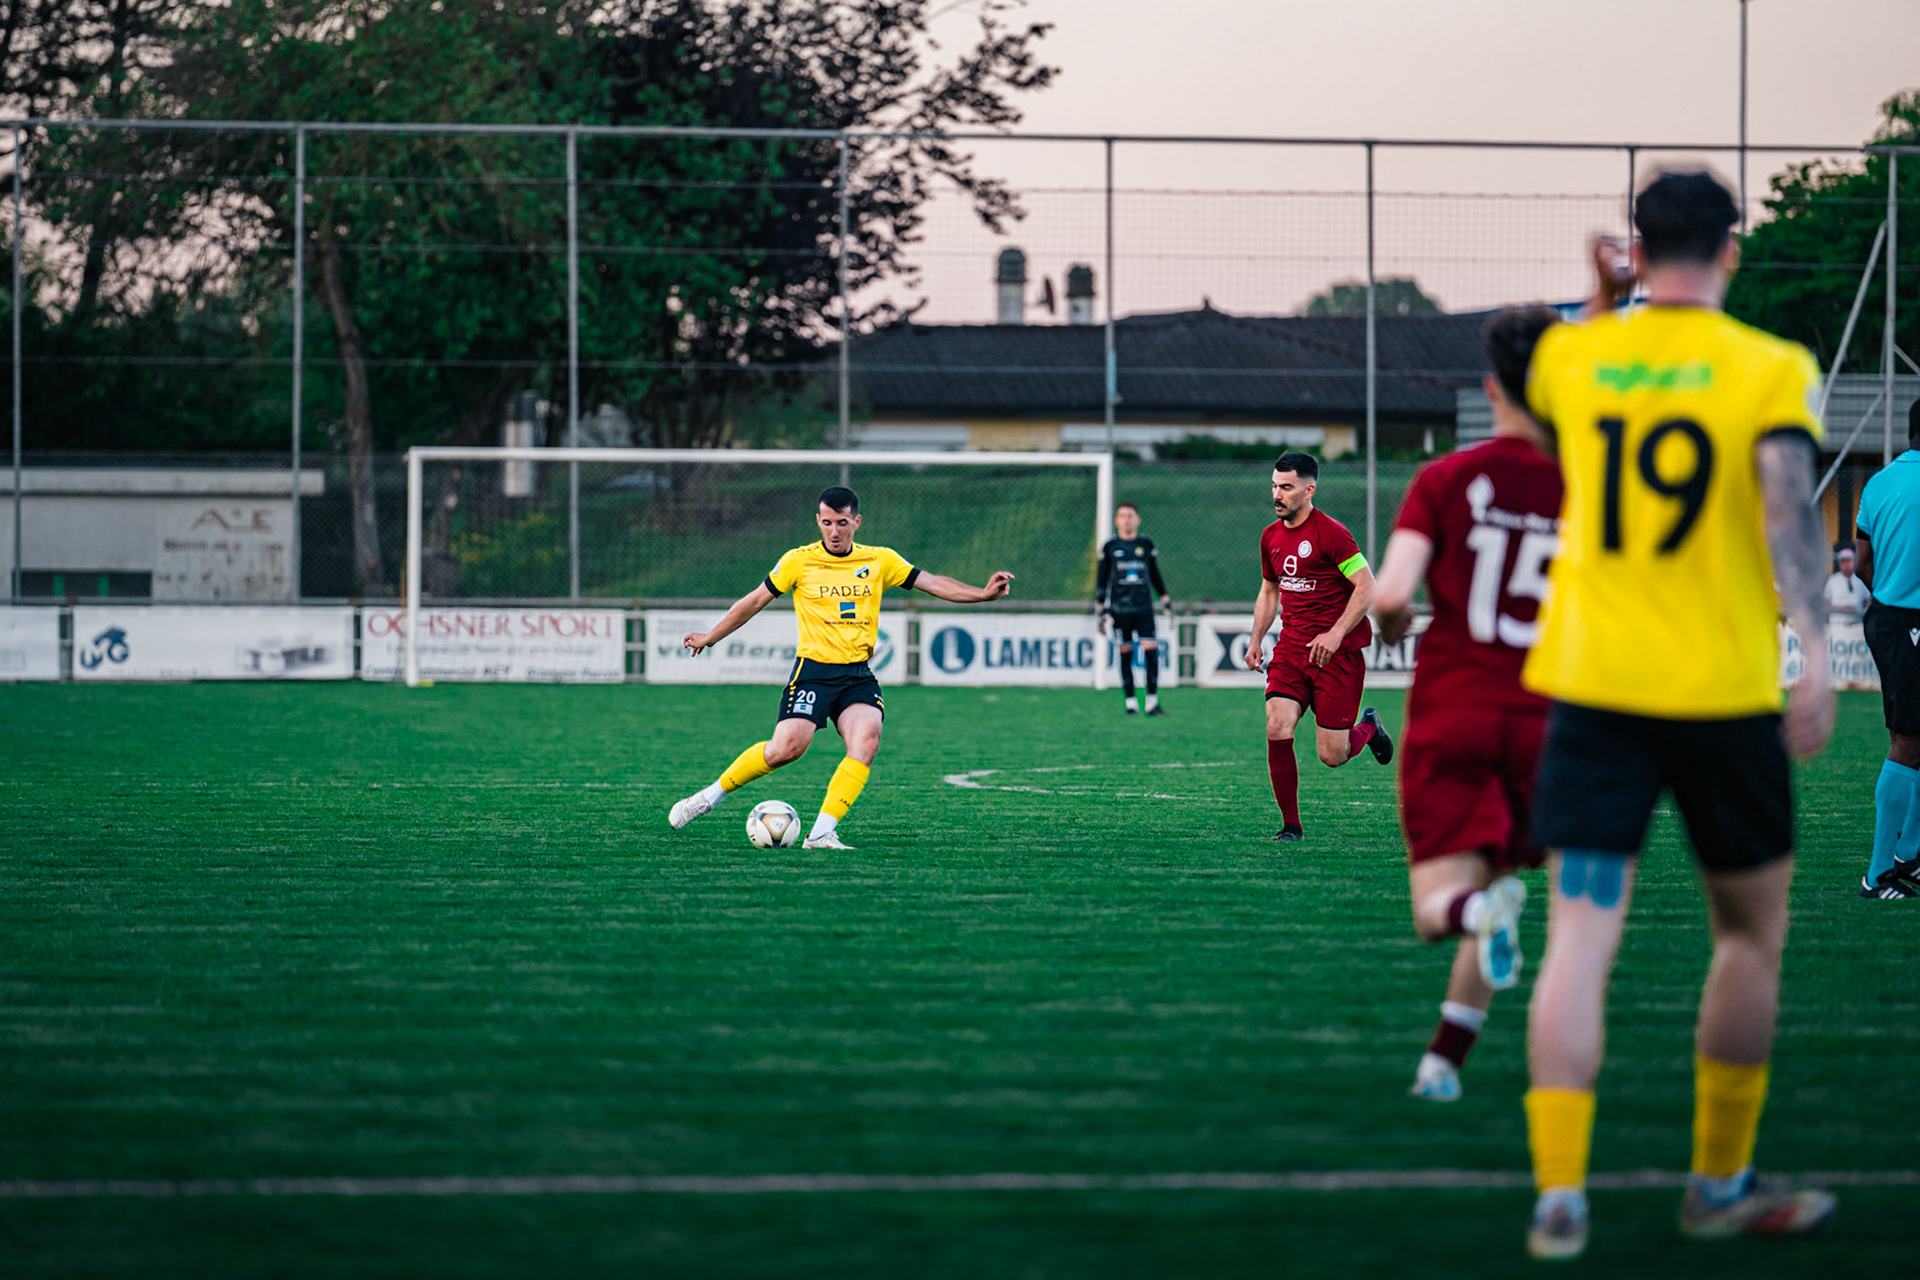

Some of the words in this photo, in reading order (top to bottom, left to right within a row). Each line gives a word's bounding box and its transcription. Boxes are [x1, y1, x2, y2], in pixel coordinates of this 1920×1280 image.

[1596, 415, 1714, 556] 19
[819, 585, 872, 598] PADEA
[1466, 525, 1563, 648] 15
[367, 609, 512, 638] OCHSNER
[520, 611, 614, 638] SPORT
[727, 642, 797, 662] Berg
[983, 637, 1170, 669] LAMELCOR
[795, 689, 817, 705] 20
